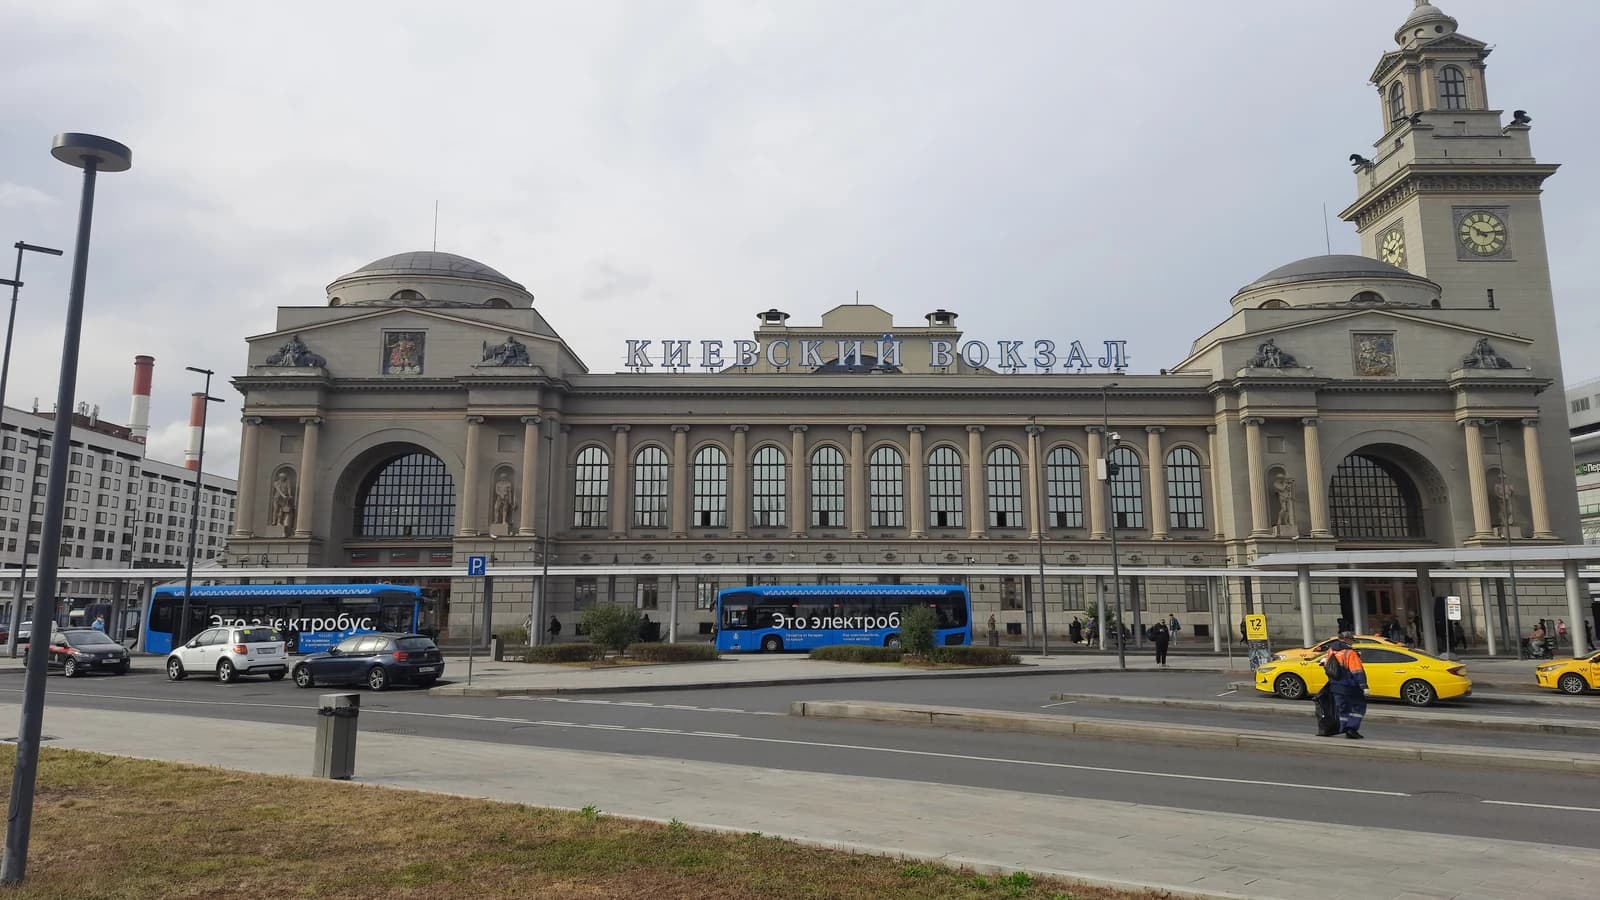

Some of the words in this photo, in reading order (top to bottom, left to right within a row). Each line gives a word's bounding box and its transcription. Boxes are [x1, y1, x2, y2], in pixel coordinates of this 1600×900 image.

[625, 333, 903, 367] КИЕВСКИЙ
[929, 340, 1129, 368] ВОКЗАЛ
[472, 558, 483, 574] P
[771, 612, 807, 629] Это
[811, 612, 902, 632] электроб
